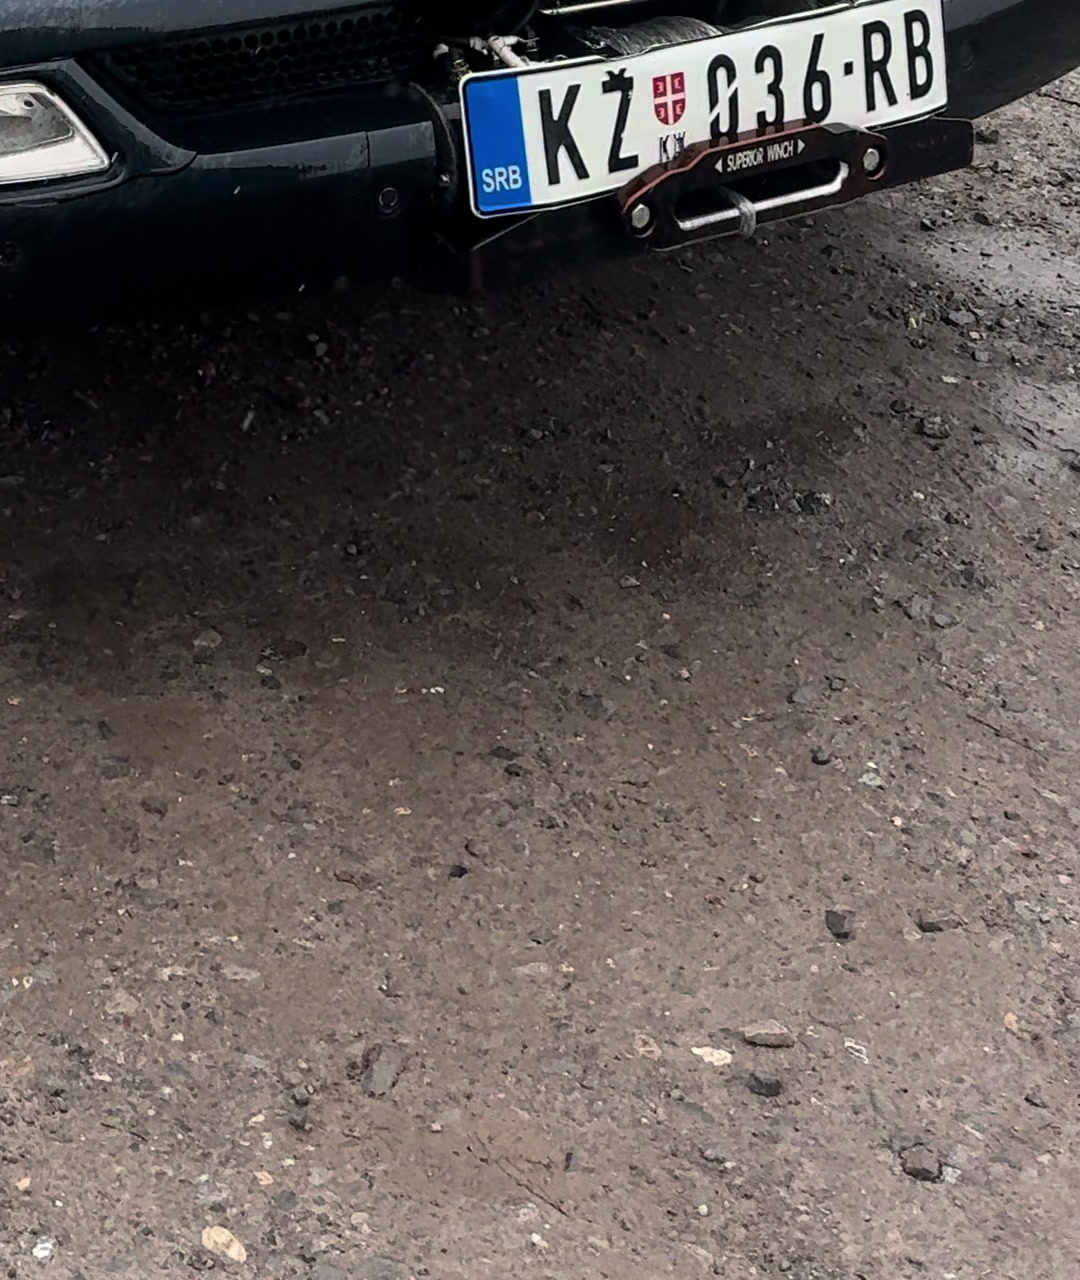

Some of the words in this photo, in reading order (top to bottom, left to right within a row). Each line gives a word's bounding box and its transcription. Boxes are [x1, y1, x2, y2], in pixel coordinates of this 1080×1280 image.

[537, 67, 639, 186] KŽ
[726, 148, 764, 172] SUPERIOR
[767, 139, 794, 163] WINCH
[481, 164, 523, 193] SRB
